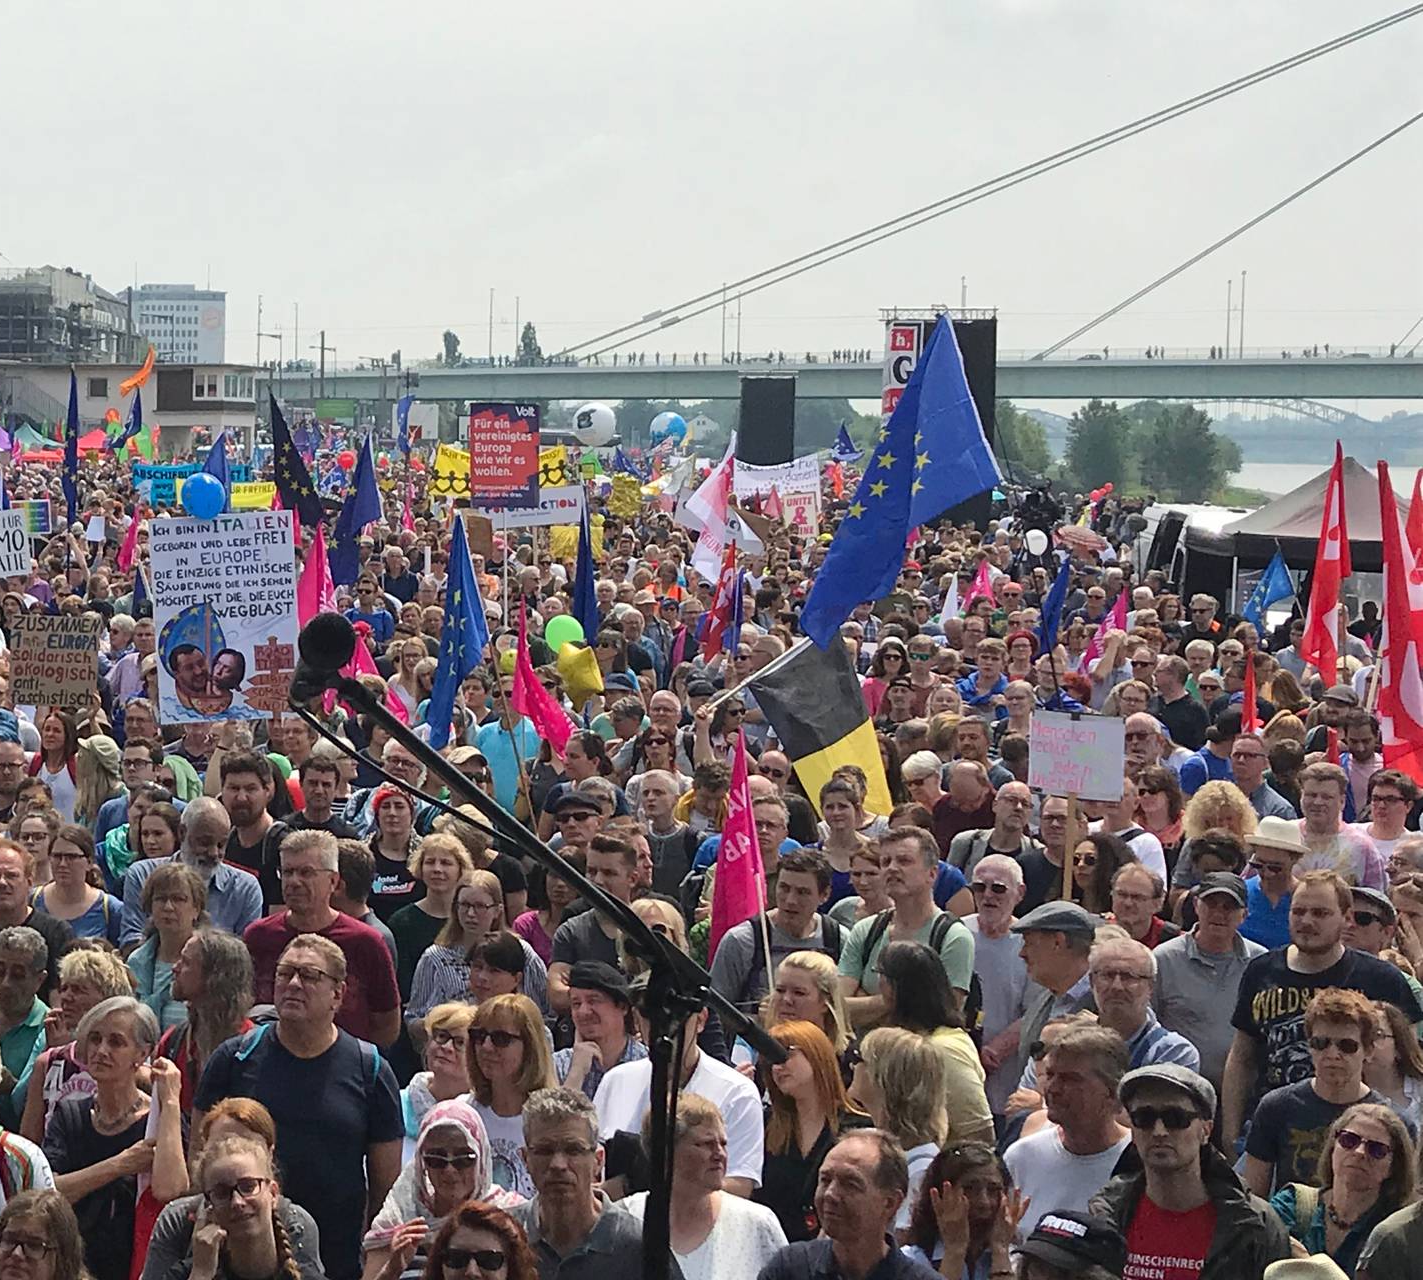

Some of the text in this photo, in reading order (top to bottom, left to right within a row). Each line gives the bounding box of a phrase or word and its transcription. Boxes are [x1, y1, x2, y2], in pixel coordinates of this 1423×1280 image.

[515, 406, 535, 417] Volt
[474, 418, 510, 429] Für ein
[474, 431, 533, 443] vereinigtes
[474, 442, 512, 454] Europa
[474, 454, 526, 464] wie wir es
[474, 467, 513, 476] wollen.
[175, 520, 195, 535] BIN
[197, 519, 210, 533] IN
[212, 515, 289, 533] ITALIEN
[154, 530, 286, 552] GEBOREN UND LEBE FREI
[177, 558, 188, 566] IN
[154, 562, 293, 580] DIE EINZIGE ETHNISCHE
[225, 581, 240, 589] DIE
[243, 580, 258, 588] ICH
[260, 577, 292, 587] SEHEN
[156, 594, 197, 607] MÖCHTE
[203, 592, 222, 604] IST
[249, 590, 265, 601] DIE
[267, 588, 294, 600] EUCH
[218, 601, 293, 618] WEGBLAST
[13, 615, 101, 633] ZUSAMMEN
[47, 633, 97, 651] EUROPA
[12, 648, 92, 664] solidarisch
[14, 662, 96, 684] ökologisch
[13, 675, 46, 690] anti-
[11, 688, 94, 706] faschistisch
